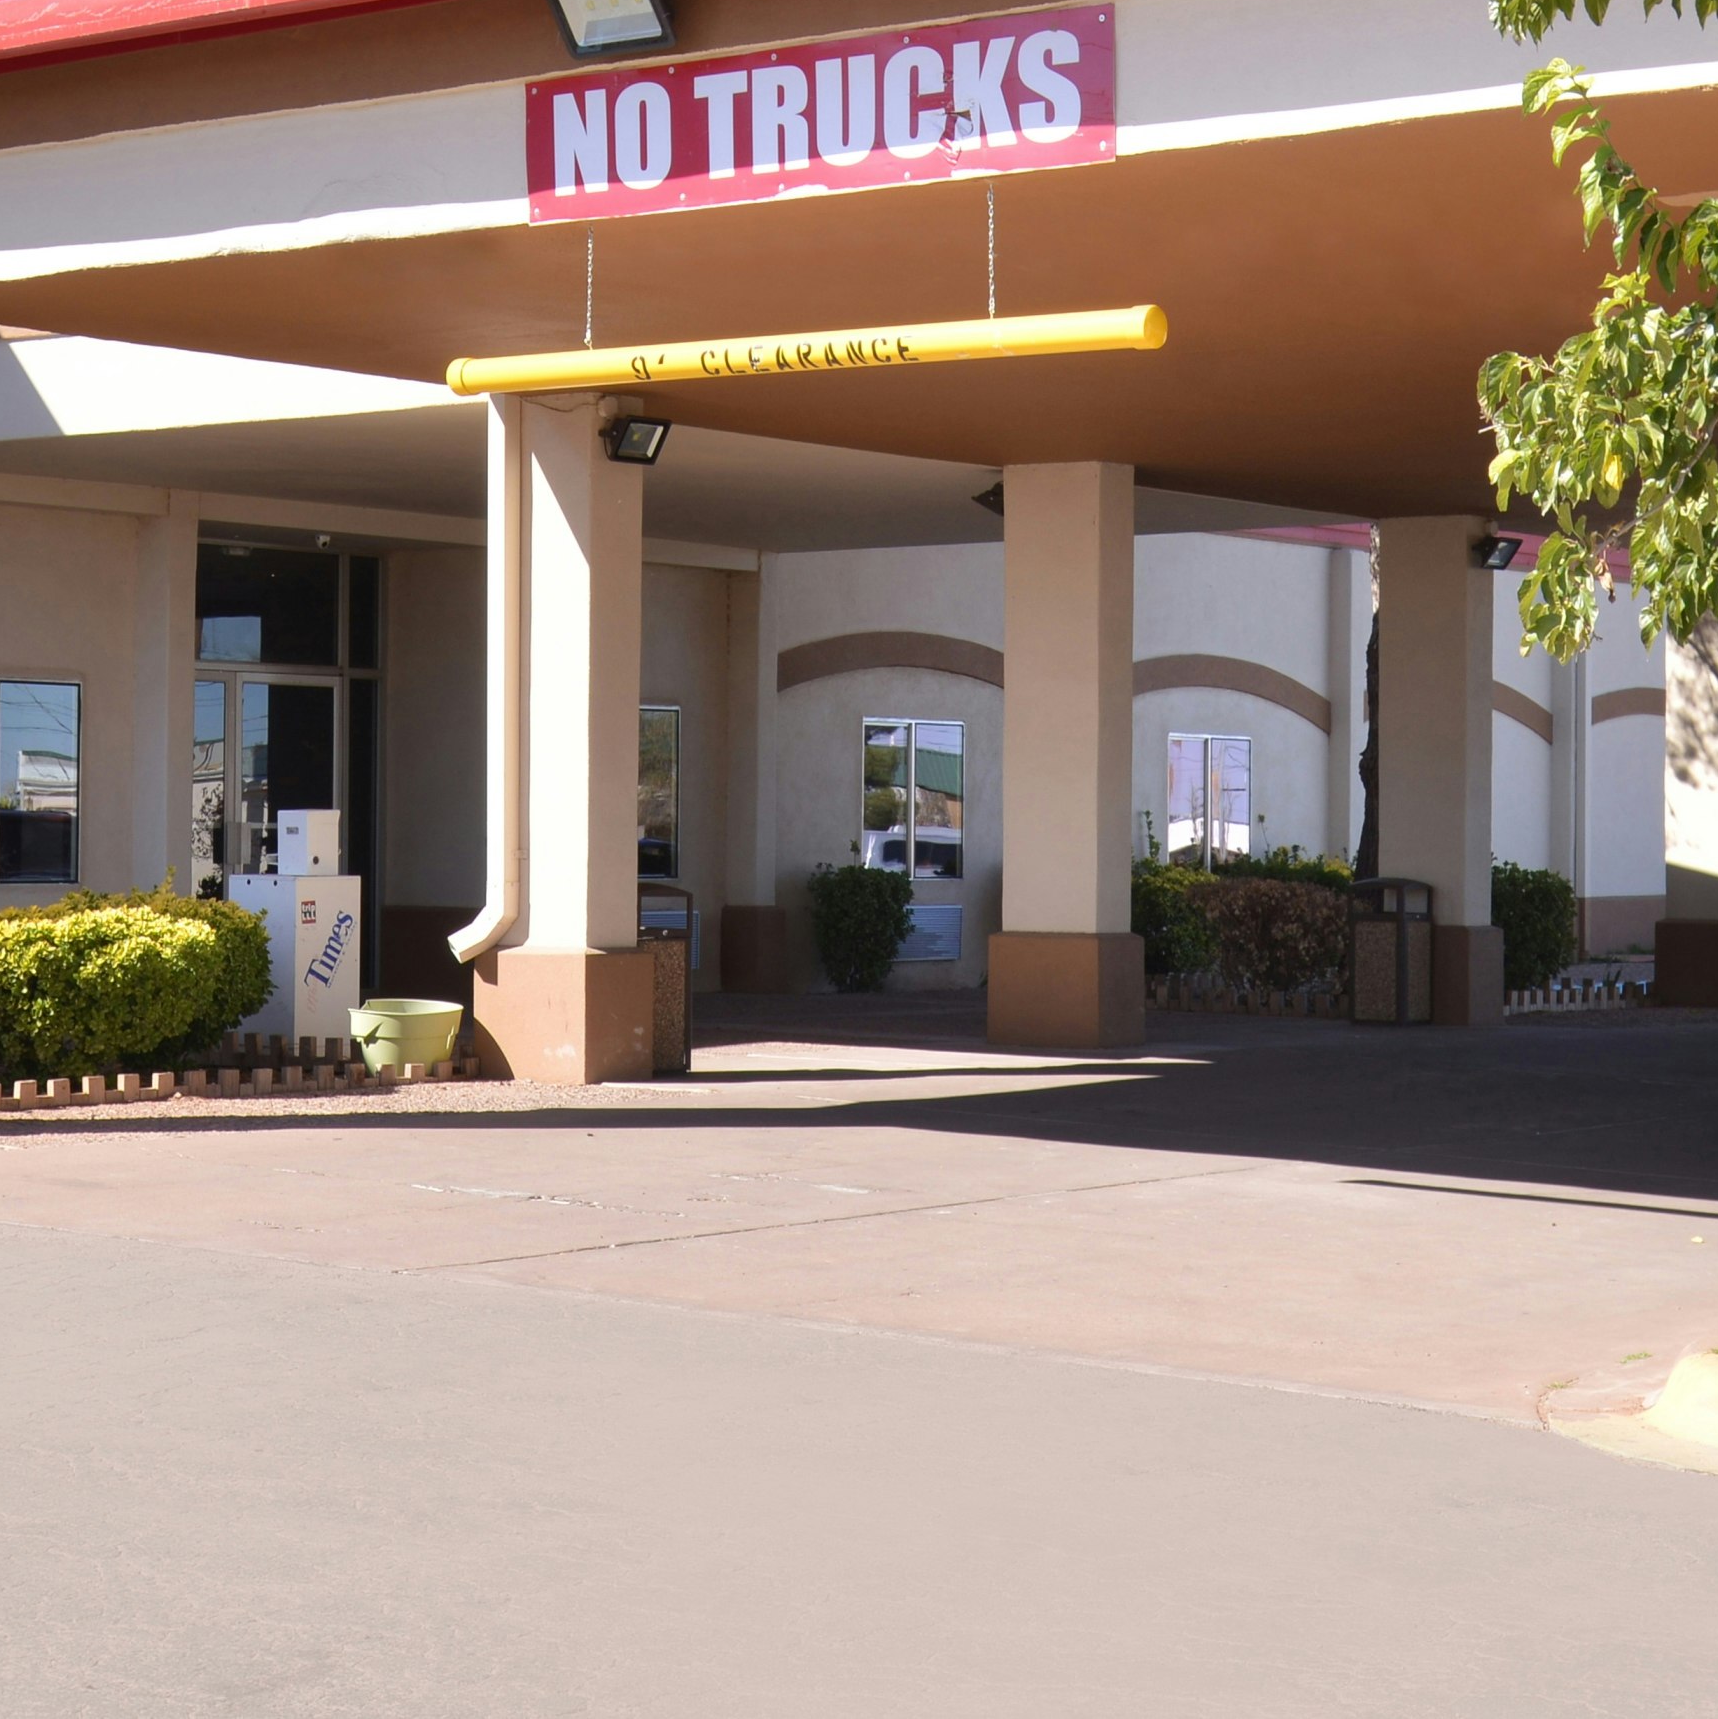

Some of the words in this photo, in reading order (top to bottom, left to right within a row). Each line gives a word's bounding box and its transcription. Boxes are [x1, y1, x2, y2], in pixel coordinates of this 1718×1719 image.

[552, 81, 672, 198] NO
[694, 29, 1082, 180] TRUCKS
[700, 336, 920, 376] CLEARANCE
[304, 910, 354, 988] Times
